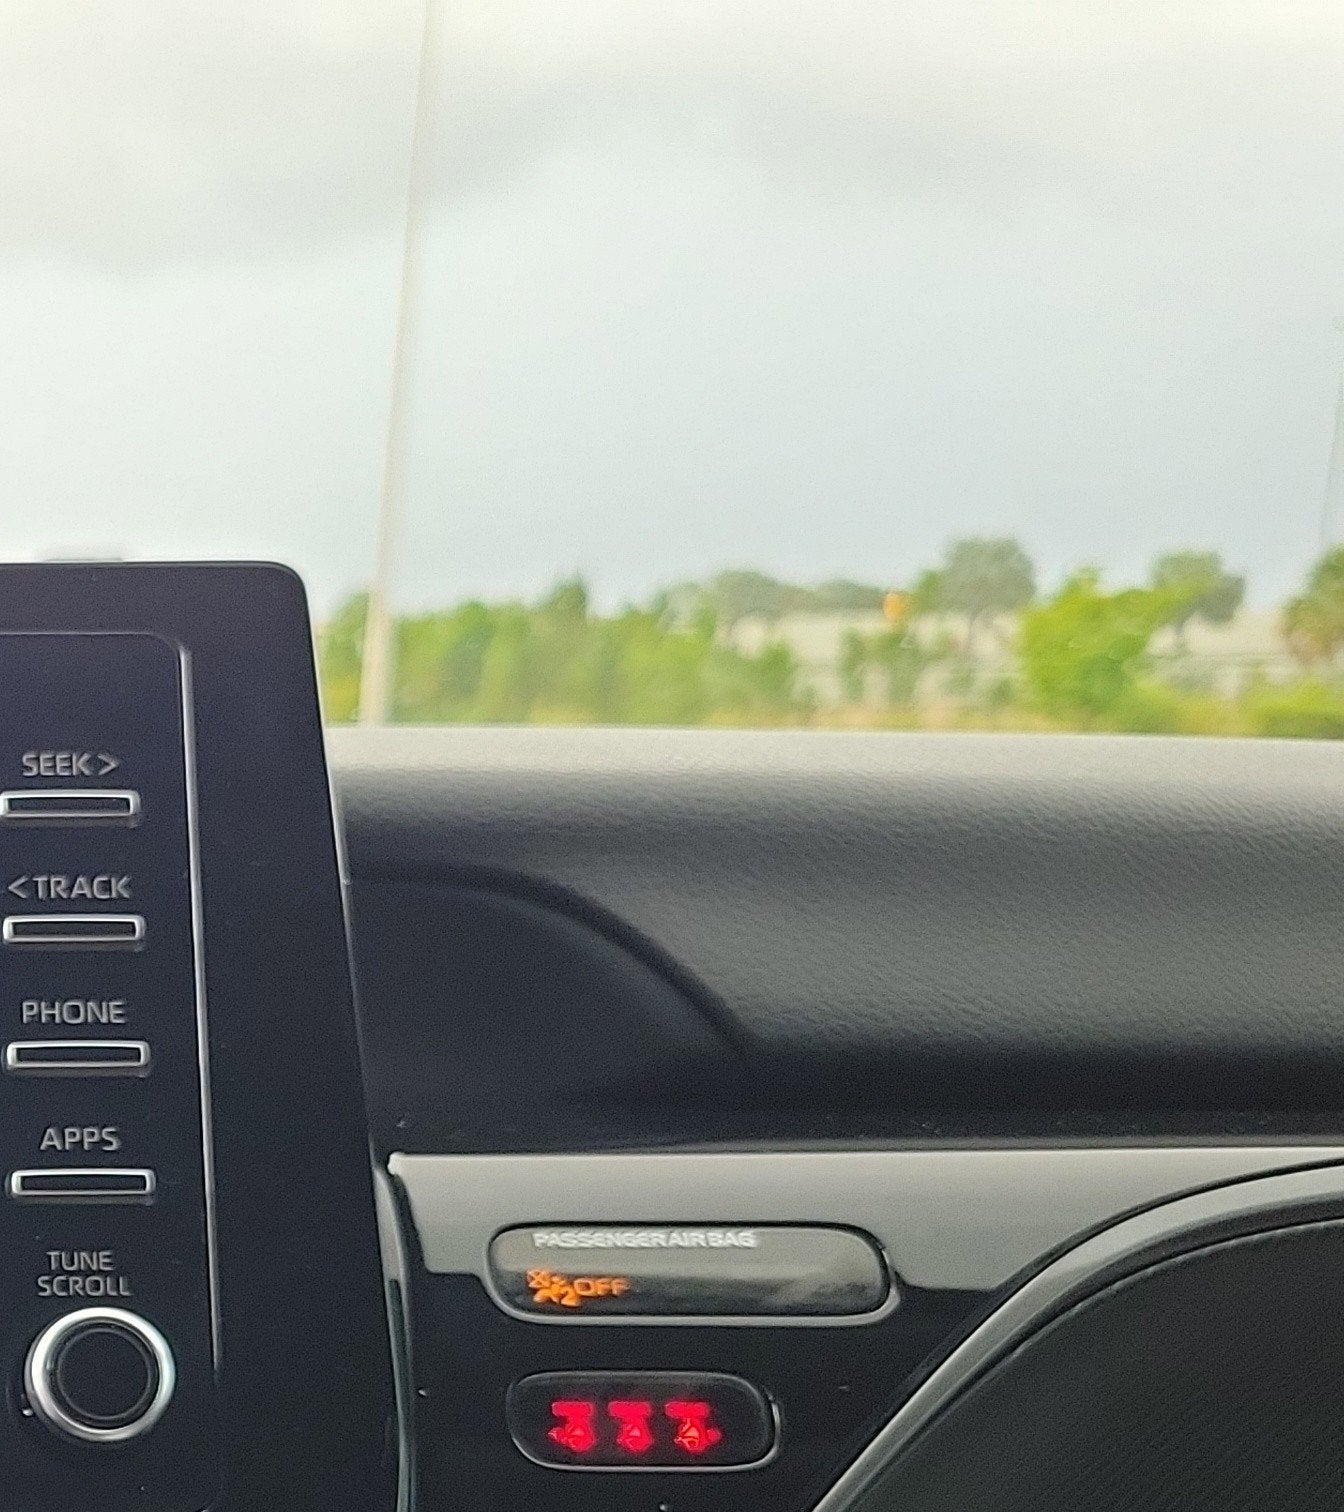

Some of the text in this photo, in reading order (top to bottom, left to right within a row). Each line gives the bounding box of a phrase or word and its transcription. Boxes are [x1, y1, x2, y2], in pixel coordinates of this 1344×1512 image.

[22, 752, 91, 776] SEEK
[33, 876, 129, 899] TRACK
[23, 1000, 125, 1023] PHONE
[41, 1127, 120, 1150] APPS
[534, 1232, 669, 1249] PASSENGER
[47, 1251, 113, 1270] TUNE
[38, 1276, 130, 1296] SCROLL
[574, 1279, 629, 1296] OFF
